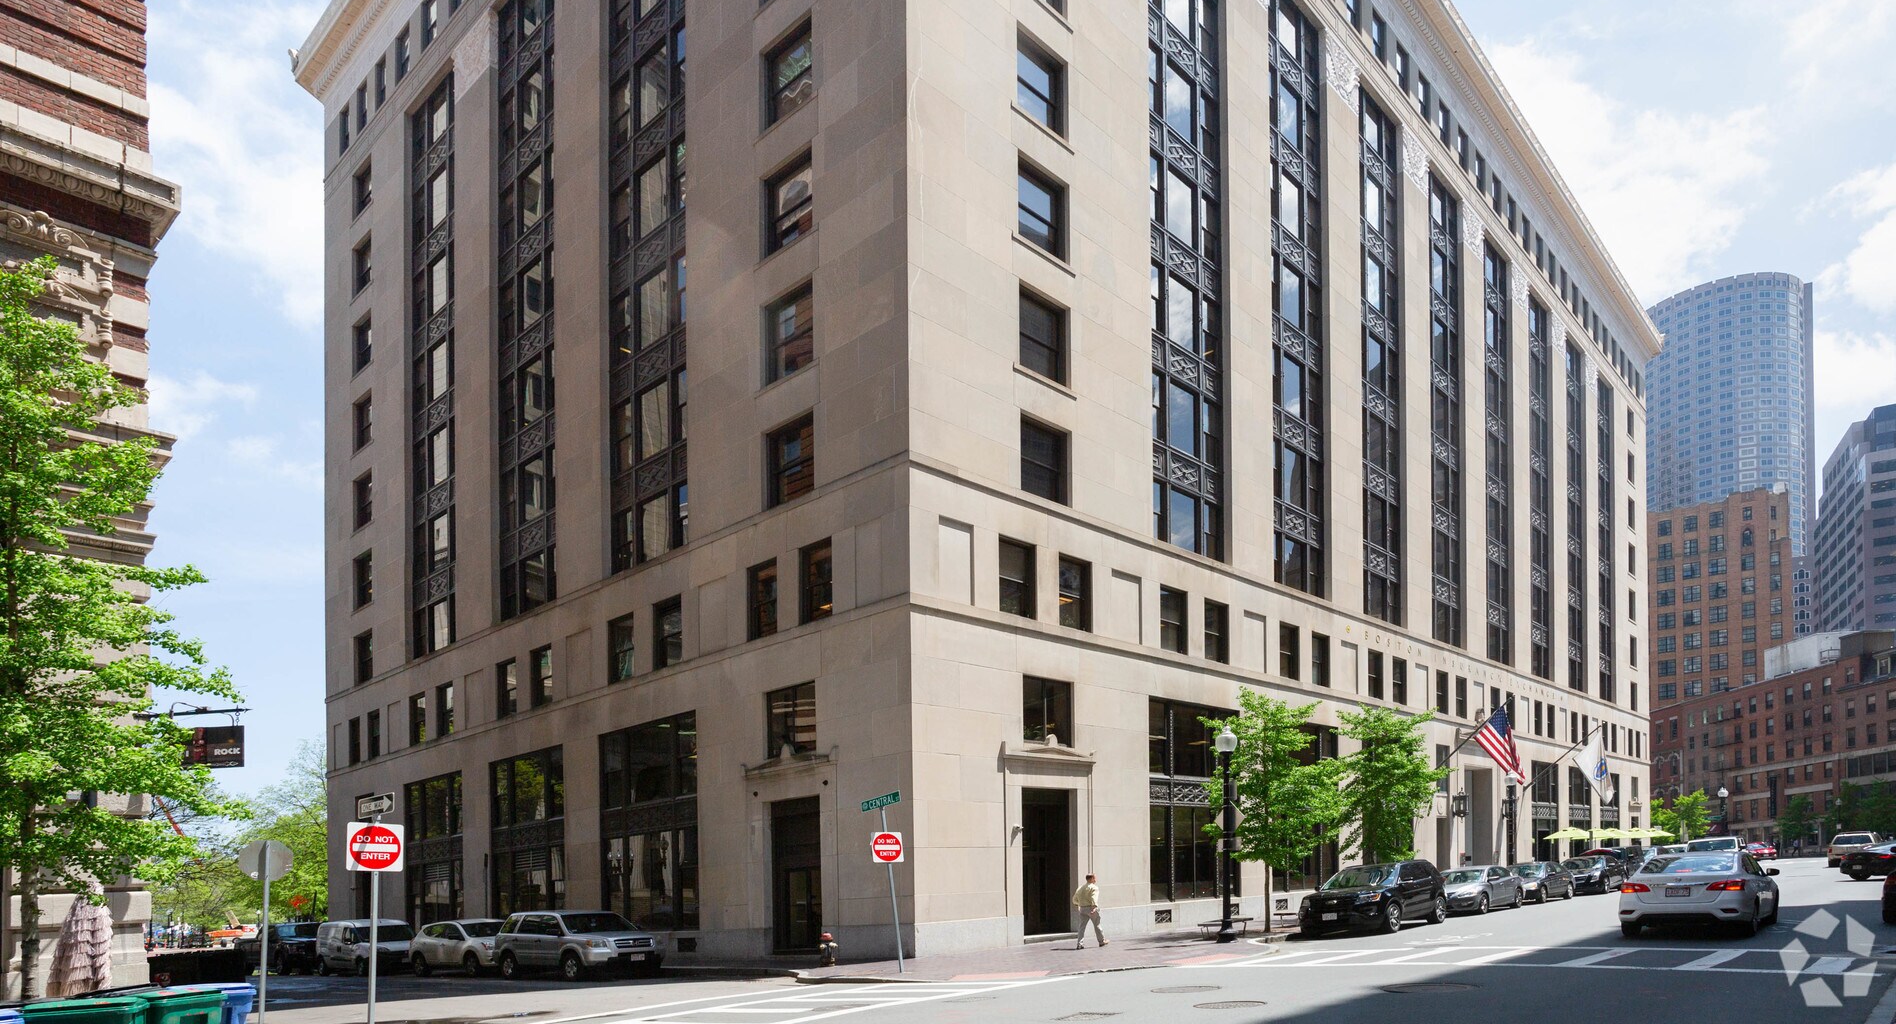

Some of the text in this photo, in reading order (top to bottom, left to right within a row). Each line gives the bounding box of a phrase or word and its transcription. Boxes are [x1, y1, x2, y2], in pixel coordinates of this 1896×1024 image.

[1364, 630, 1555, 700] BOSTON INSURANCE EXCHANGE
[214, 747, 241, 756] ROCK
[362, 801, 384, 811] ONE WAY
[869, 794, 895, 809] CENTRAL
[360, 852, 391, 860] ENTER
